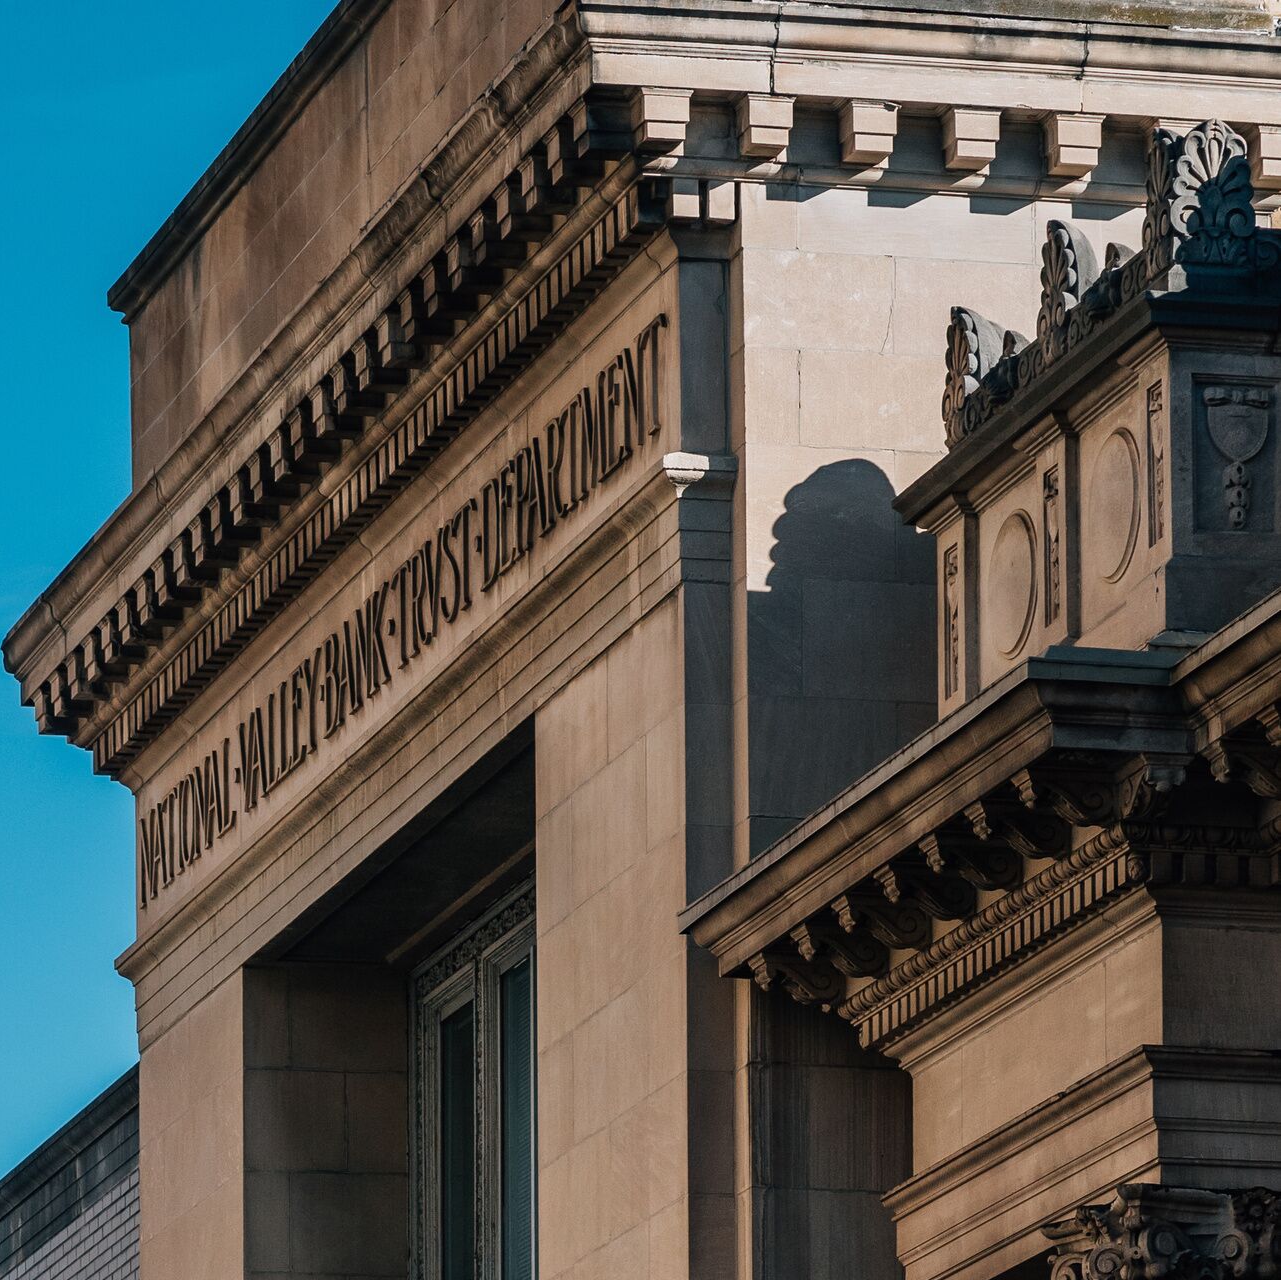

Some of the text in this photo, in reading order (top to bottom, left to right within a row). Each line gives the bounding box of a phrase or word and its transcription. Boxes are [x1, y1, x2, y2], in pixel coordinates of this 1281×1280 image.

[140, 737, 237, 909] NATIONAL
[239, 647, 321, 813] VALLEY
[323, 581, 392, 740] BANK
[479, 312, 667, 593] DEPARTMENT
